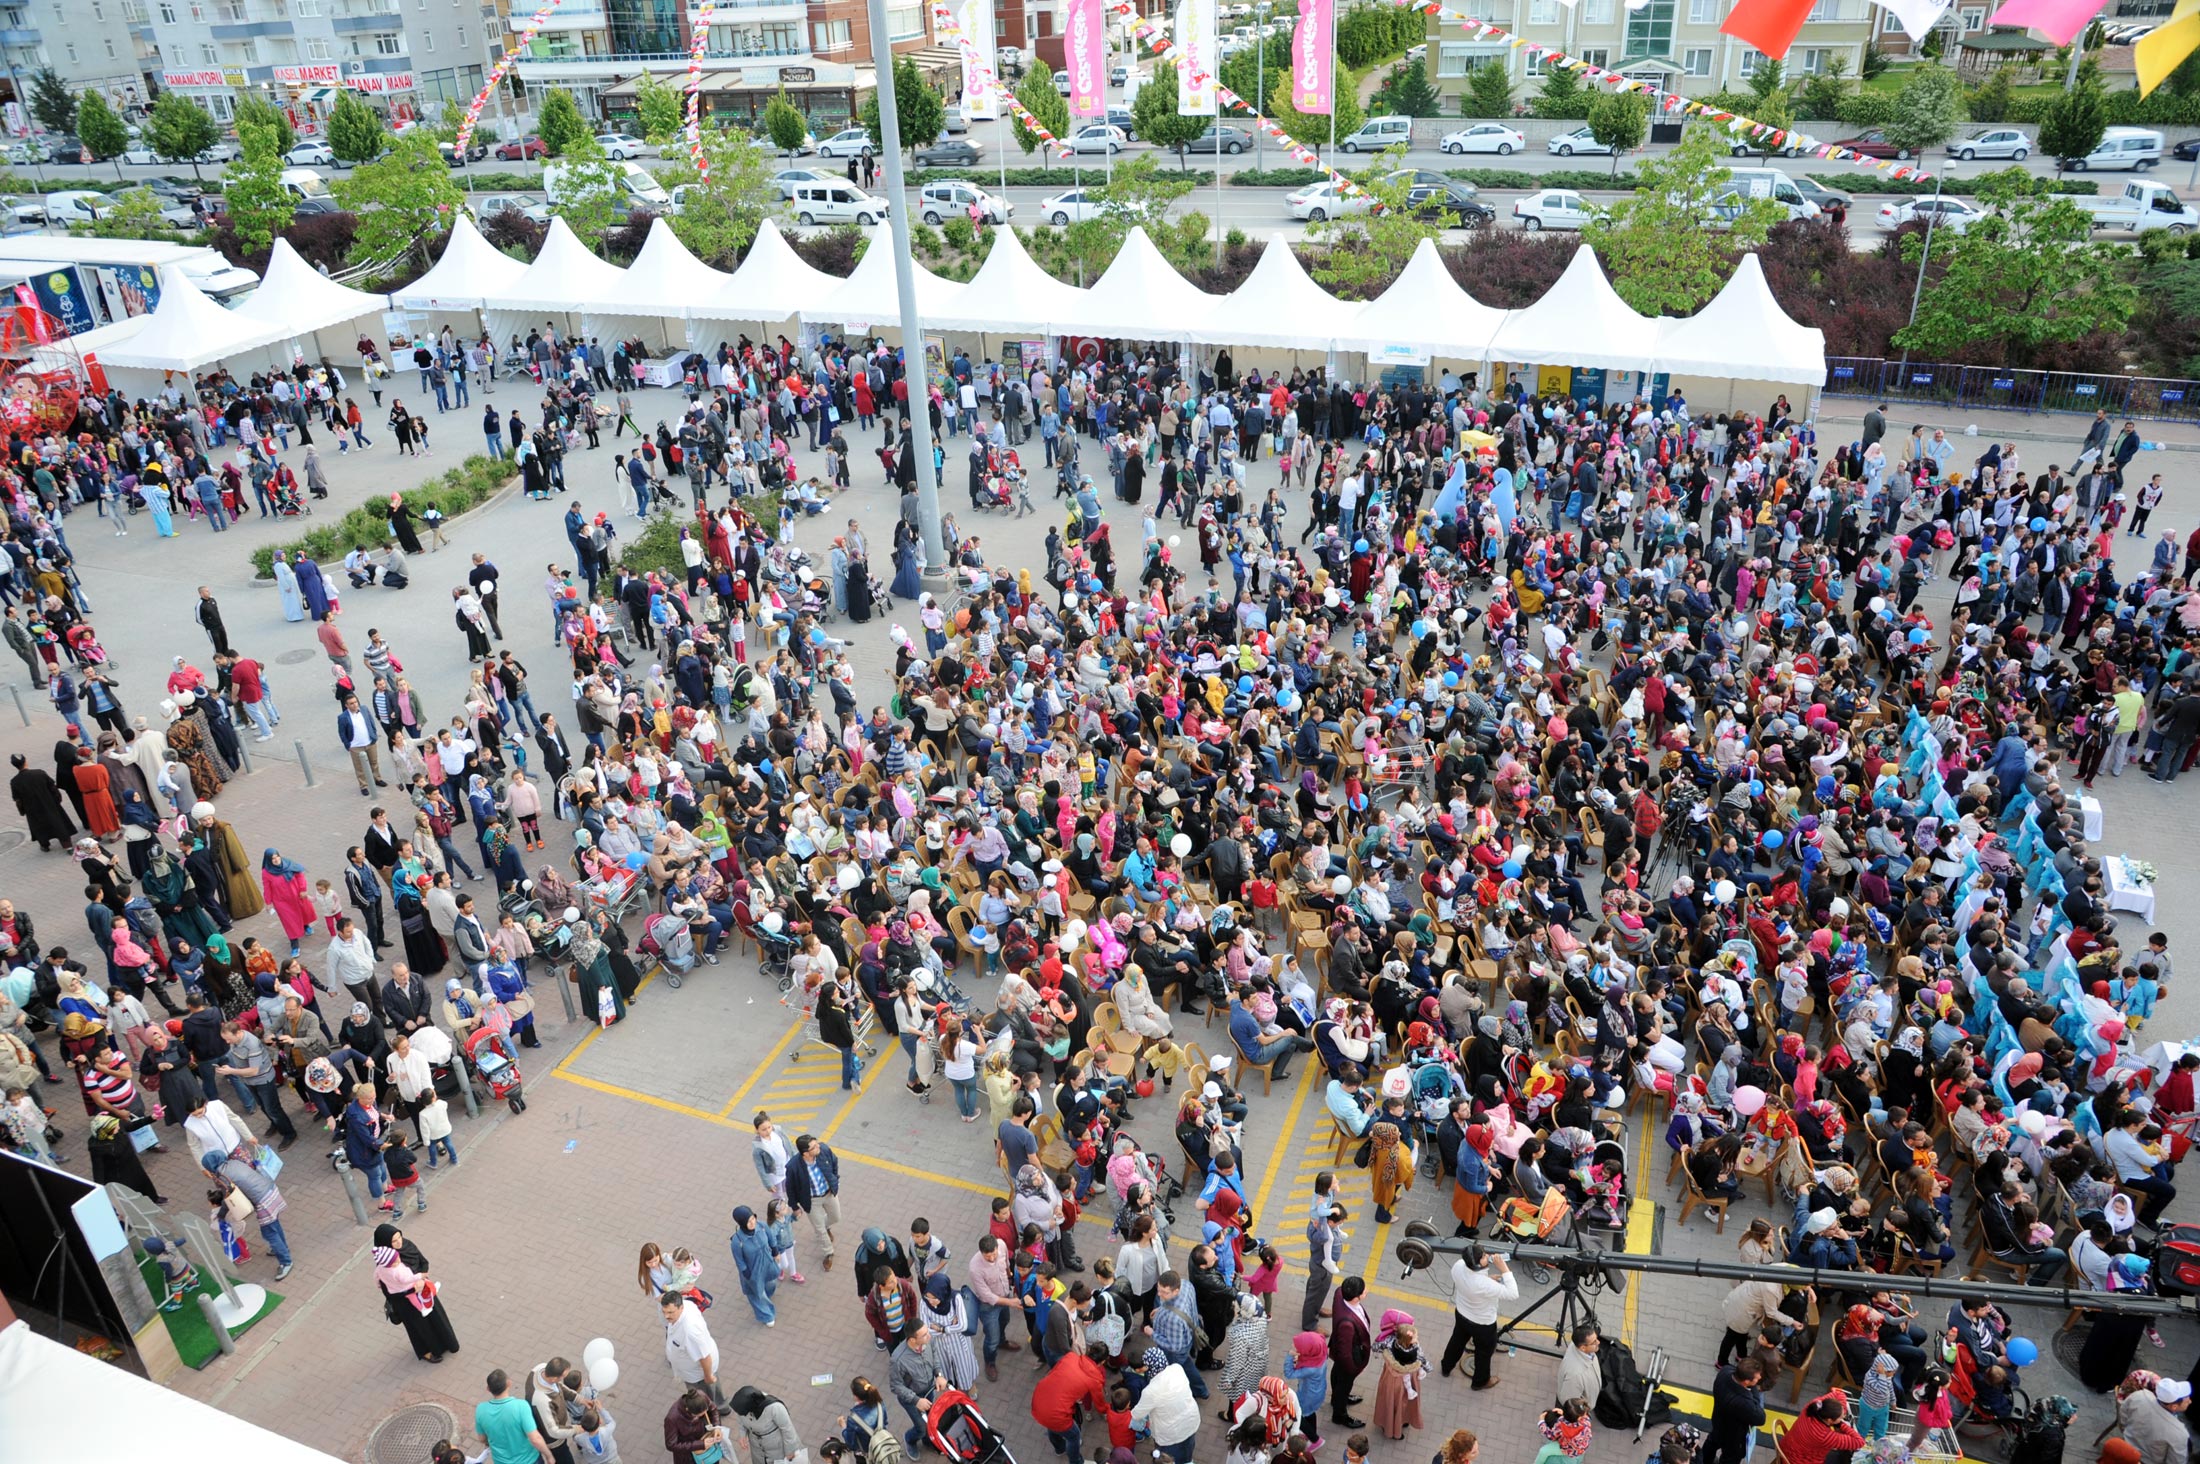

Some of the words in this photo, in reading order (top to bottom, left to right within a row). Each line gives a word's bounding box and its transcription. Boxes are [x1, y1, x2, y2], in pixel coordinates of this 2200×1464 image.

[299, 66, 338, 81] MARKET
[346, 78, 383, 92] MANAV
[386, 74, 413, 89] MANAV
[1912, 375, 1931, 383] POLİS
[2076, 385, 2096, 394] POLİS
